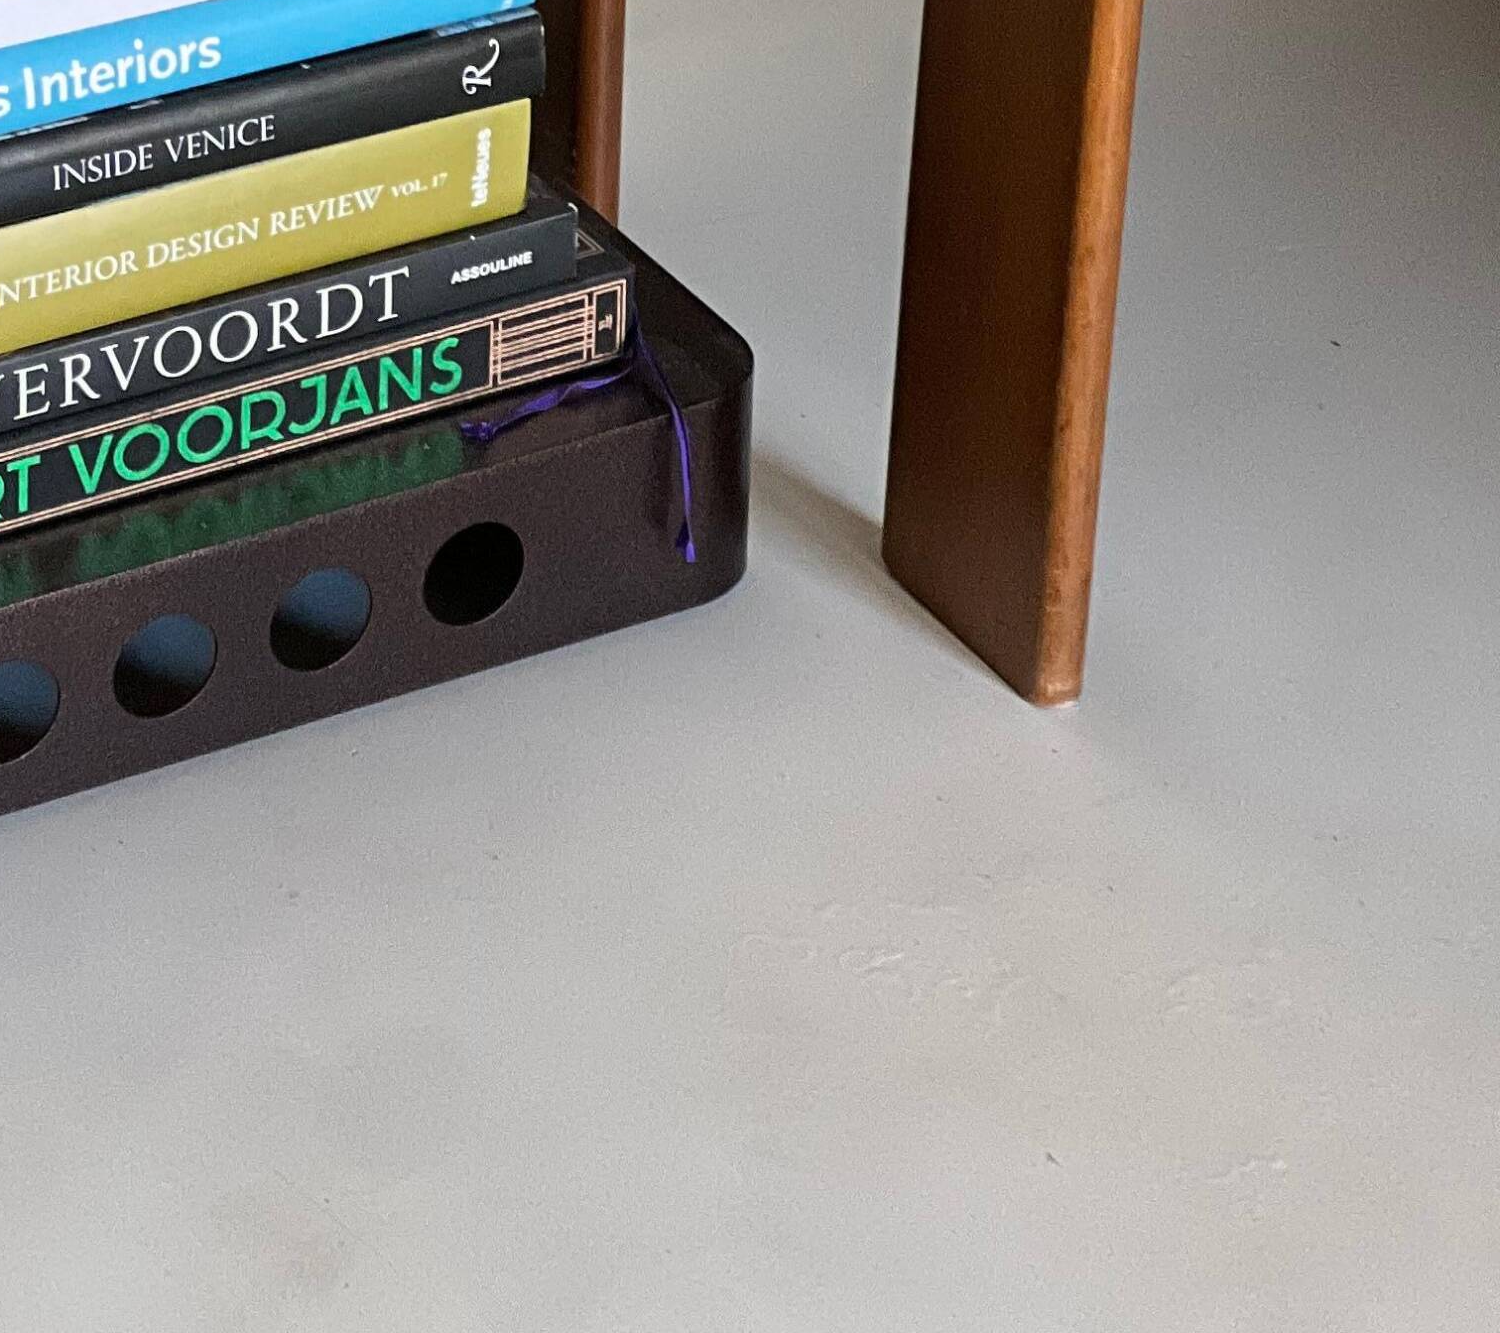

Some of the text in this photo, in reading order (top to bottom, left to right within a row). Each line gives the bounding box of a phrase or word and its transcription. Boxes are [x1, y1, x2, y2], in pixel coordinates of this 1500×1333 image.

[22, 34, 223, 111] Interiors
[462, 38, 500, 95] R
[52, 114, 275, 191] INSIDE VENICE
[146, 217, 260, 270] DESIGN
[268, 184, 385, 236] REVIEW
[431, 172, 449, 188] 17
[450, 250, 534, 285] ASSOULINE
[67, 336, 463, 495] VOORJANS
